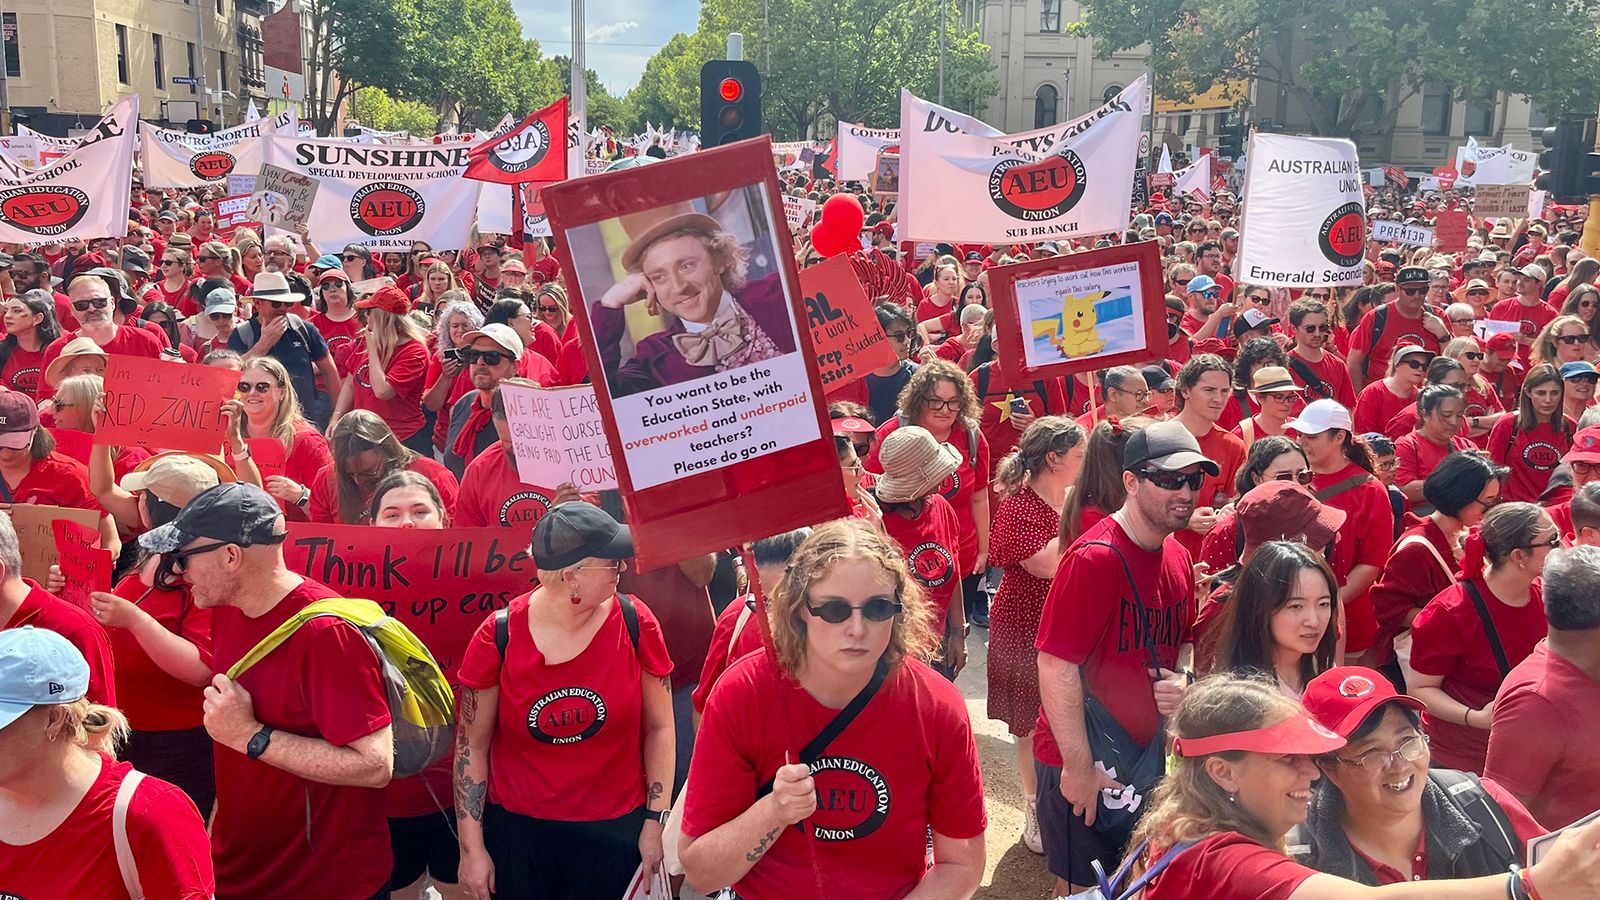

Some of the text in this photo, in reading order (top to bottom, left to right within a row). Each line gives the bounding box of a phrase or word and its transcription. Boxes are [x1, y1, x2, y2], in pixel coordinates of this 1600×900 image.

[155, 124, 261, 146] COBURG NORTH
[850, 127, 900, 140] COPPER
[198, 159, 229, 171] AEU
[296, 143, 472, 167] SUNSHINE
[263, 163, 281, 179] EVEN
[308, 167, 461, 181] SPECIAL DEVELOPMENTAL SCHOOL
[1268, 159, 1353, 174] AUSTRALIAN
[1006, 165, 1069, 196] AEU
[28, 186, 89, 206] EDUCATION
[299, 188, 309, 202] BE
[351, 182, 424, 219] AUSTRALIAN EDUCATION
[788, 196, 798, 204] THE
[11, 197, 71, 219] AEU
[291, 198, 305, 213] THIS
[363, 200, 412, 218] AEU
[1022, 206, 1060, 220] UNION
[1509, 205, 1527, 213] LAST
[34, 223, 67, 234] UNION
[374, 226, 402, 236] UNION
[1006, 222, 1078, 237] SUB BRANCH
[1334, 225, 1363, 244] AEU
[1041, 277, 1057, 287] trying
[1057, 275, 1064, 283] to
[1065, 273, 1080, 281] work
[1089, 269, 1101, 278] how
[1102, 267, 1112, 275] this
[1113, 263, 1138, 275] workload
[1250, 266, 1315, 283] Emerald
[1055, 283, 1101, 298] equals this salary
[804, 291, 843, 329] AL
[825, 308, 859, 340] work
[817, 349, 843, 367] rep
[147, 372, 161, 384] in
[180, 370, 203, 387] the
[820, 364, 854, 385] ssors
[645, 367, 771, 408] You want to be the
[102, 390, 147, 427] RED
[504, 393, 601, 420] WE ARE LEAR
[641, 381, 783, 427] Education State, with
[624, 391, 807, 450] overworked and underpaid
[511, 422, 558, 442] GASLIGHT
[689, 425, 753, 452] teachers?
[515, 441, 541, 460] BEING
[543, 446, 561, 465] PAID
[564, 445, 593, 465] THE
[673, 440, 777, 475] Please do go on
[1533, 451, 1554, 461] AEU
[570, 467, 616, 490] COUN
[501, 492, 529, 522] AUSTRALIAN
[511, 508, 543, 521] AEU
[295, 536, 531, 590] Think I'll be
[926, 542, 953, 565] EDUCATION
[411, 597, 448, 624] up
[459, 591, 510, 615] eas
[528, 687, 606, 728] AUSTRALIAN EDUCATION
[544, 705, 592, 729] AEU
[552, 734, 582, 744] UNION
[808, 758, 889, 814] ALIAN EDUCATION
[815, 827, 855, 840] UNION
